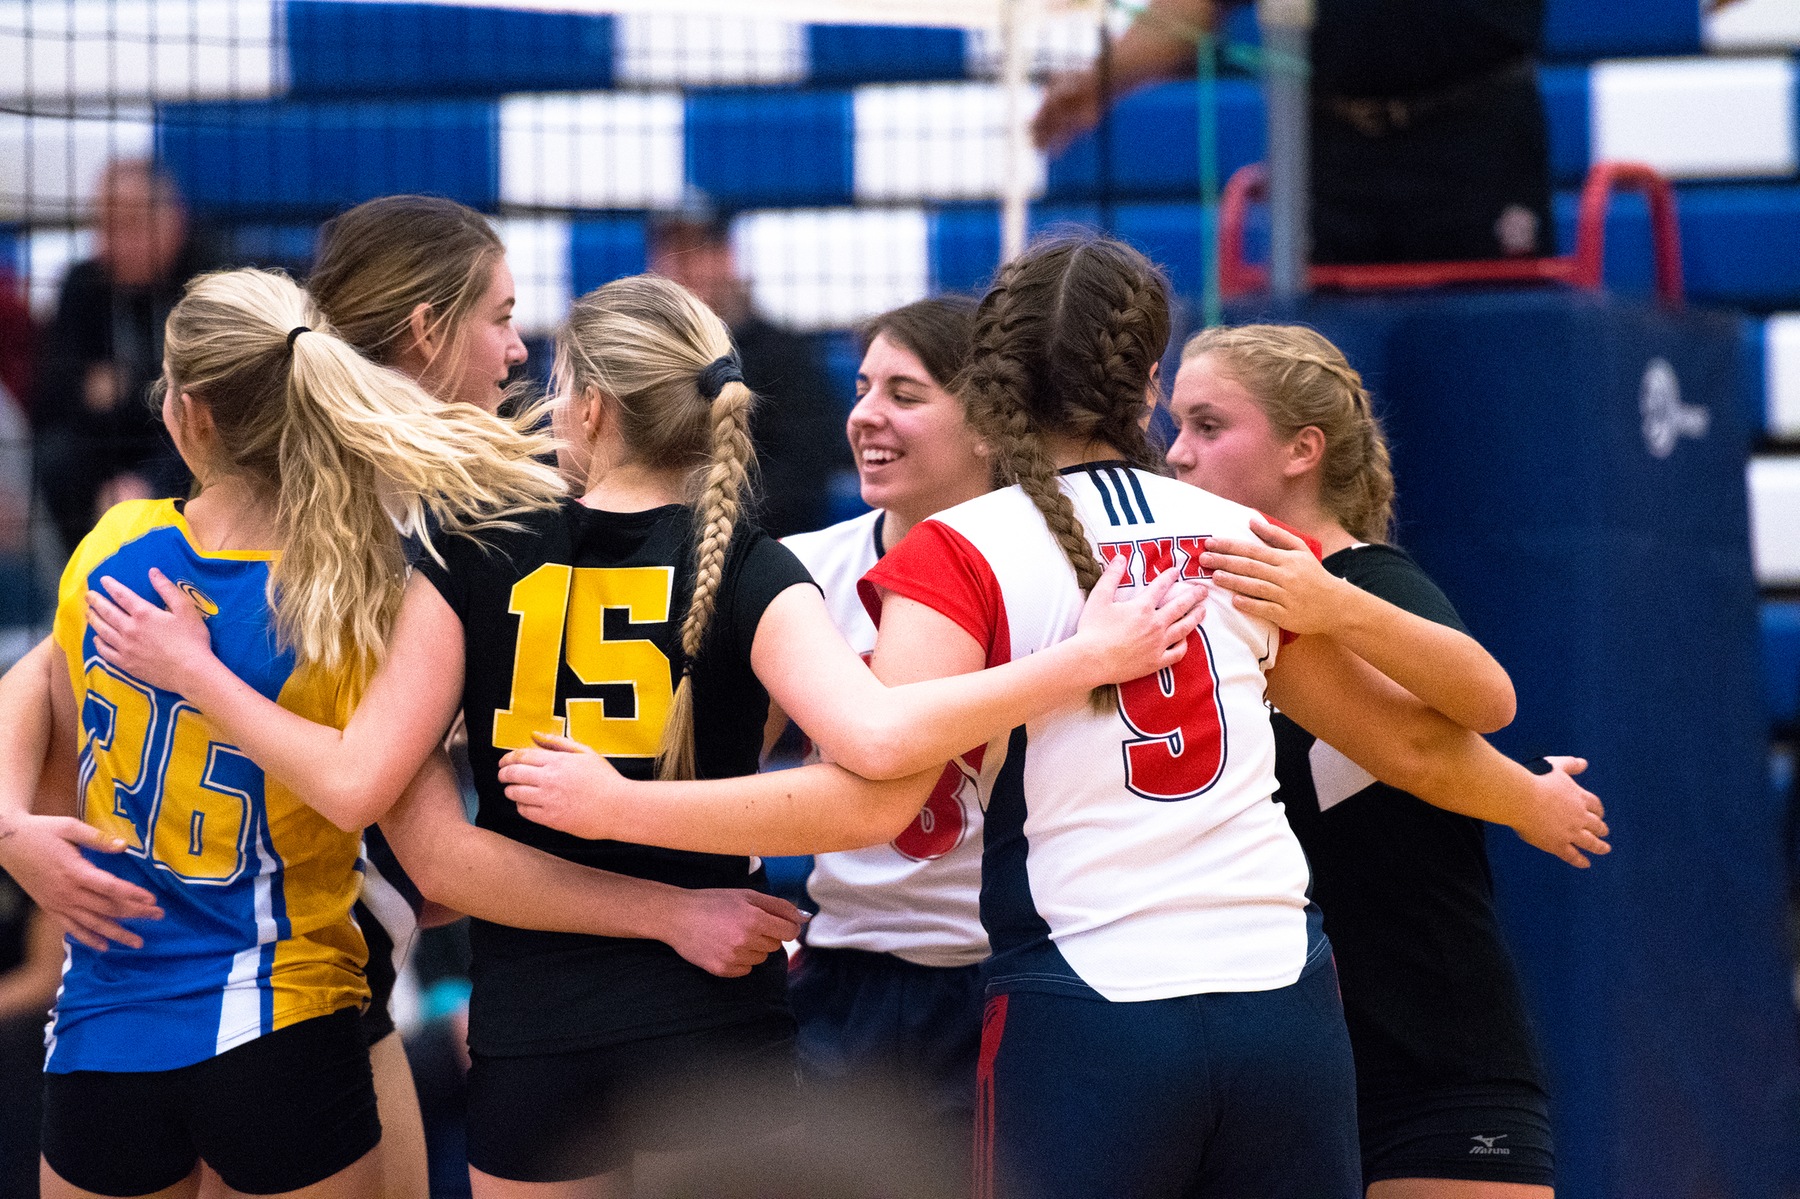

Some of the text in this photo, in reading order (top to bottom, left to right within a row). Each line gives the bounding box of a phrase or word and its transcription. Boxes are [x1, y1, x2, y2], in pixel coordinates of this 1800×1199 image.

[1097, 535, 1213, 588] YNX
[492, 562, 675, 758] 15
[1116, 622, 1228, 803] 9
[78, 655, 252, 887] 26
